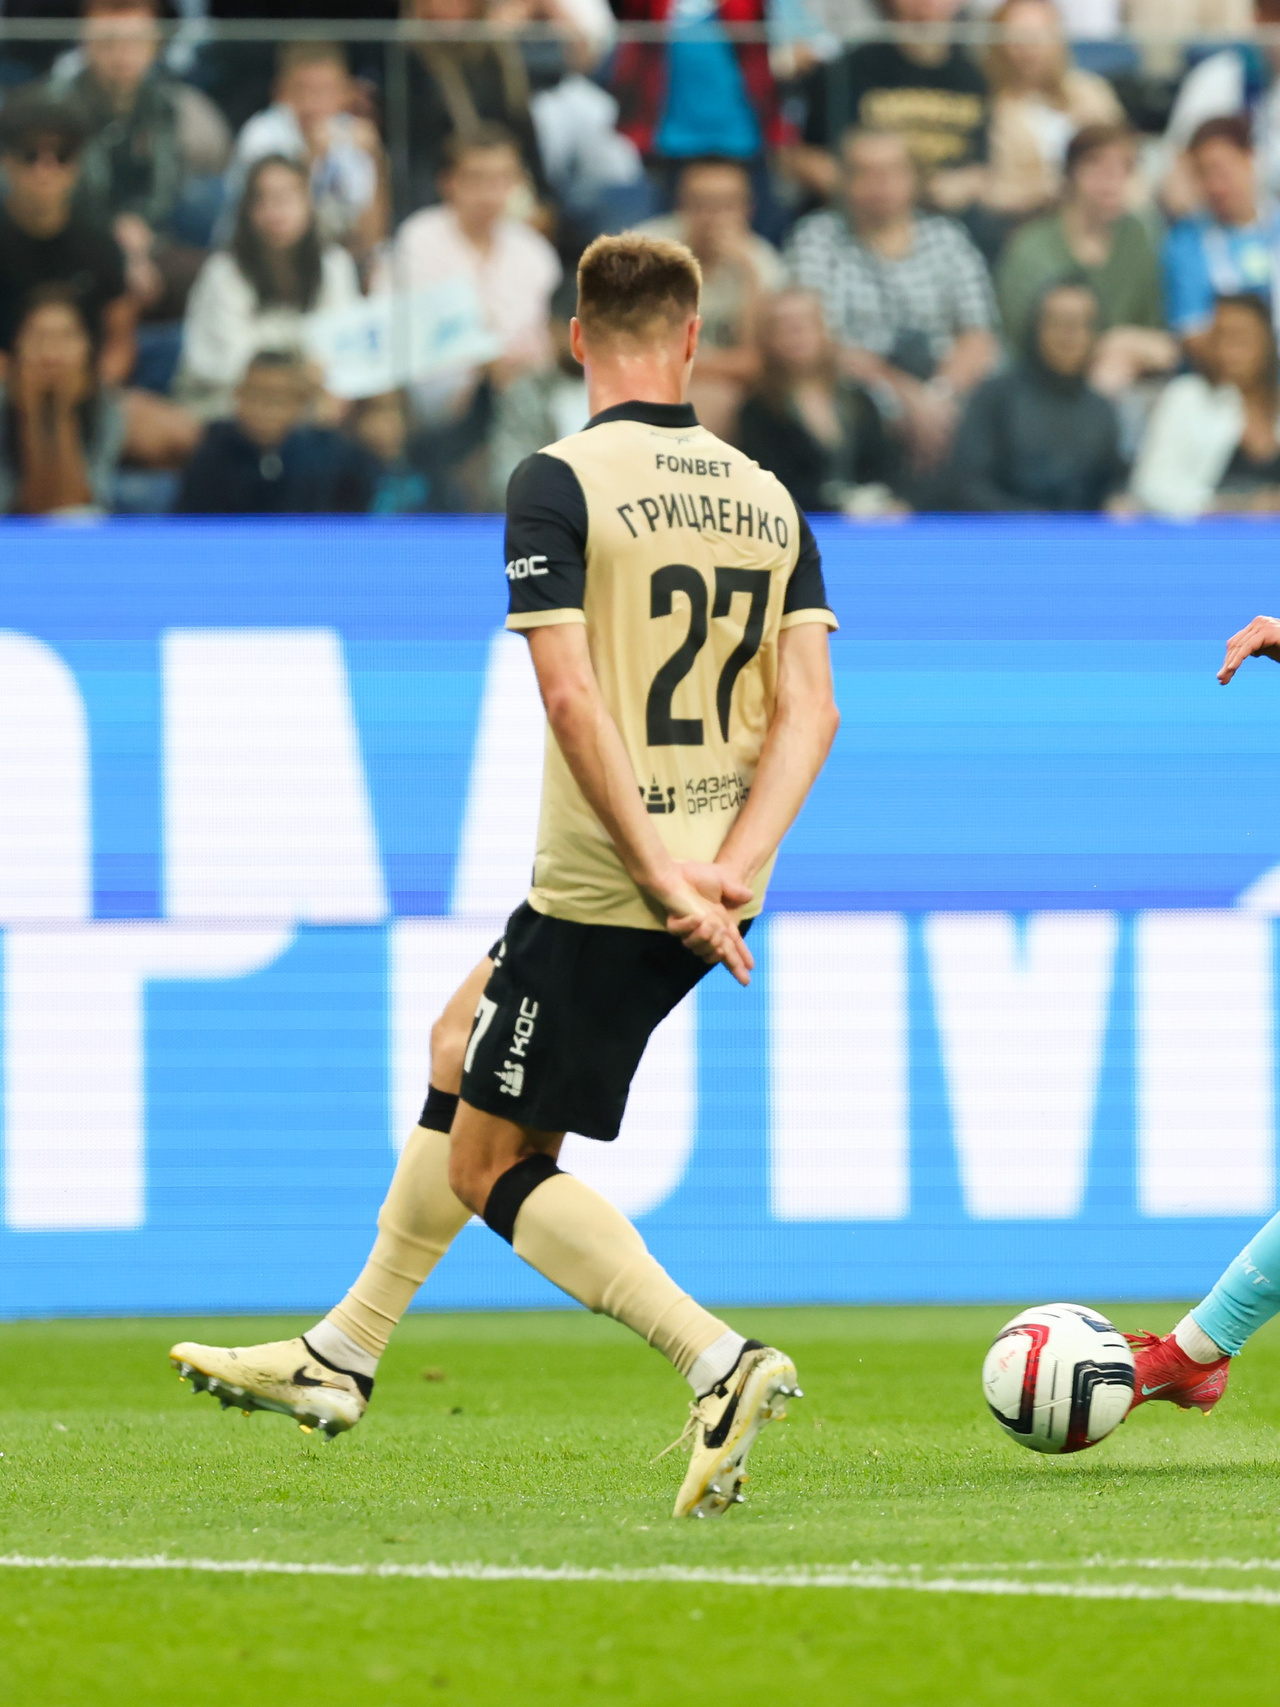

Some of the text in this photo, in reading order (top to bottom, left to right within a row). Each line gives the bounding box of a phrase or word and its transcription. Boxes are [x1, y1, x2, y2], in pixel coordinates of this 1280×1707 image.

[655, 453, 731, 478] FONBET
[616, 492, 788, 549] ГРИЦАЕНКО
[646, 563, 772, 747] 27
[463, 993, 499, 1074] 7
